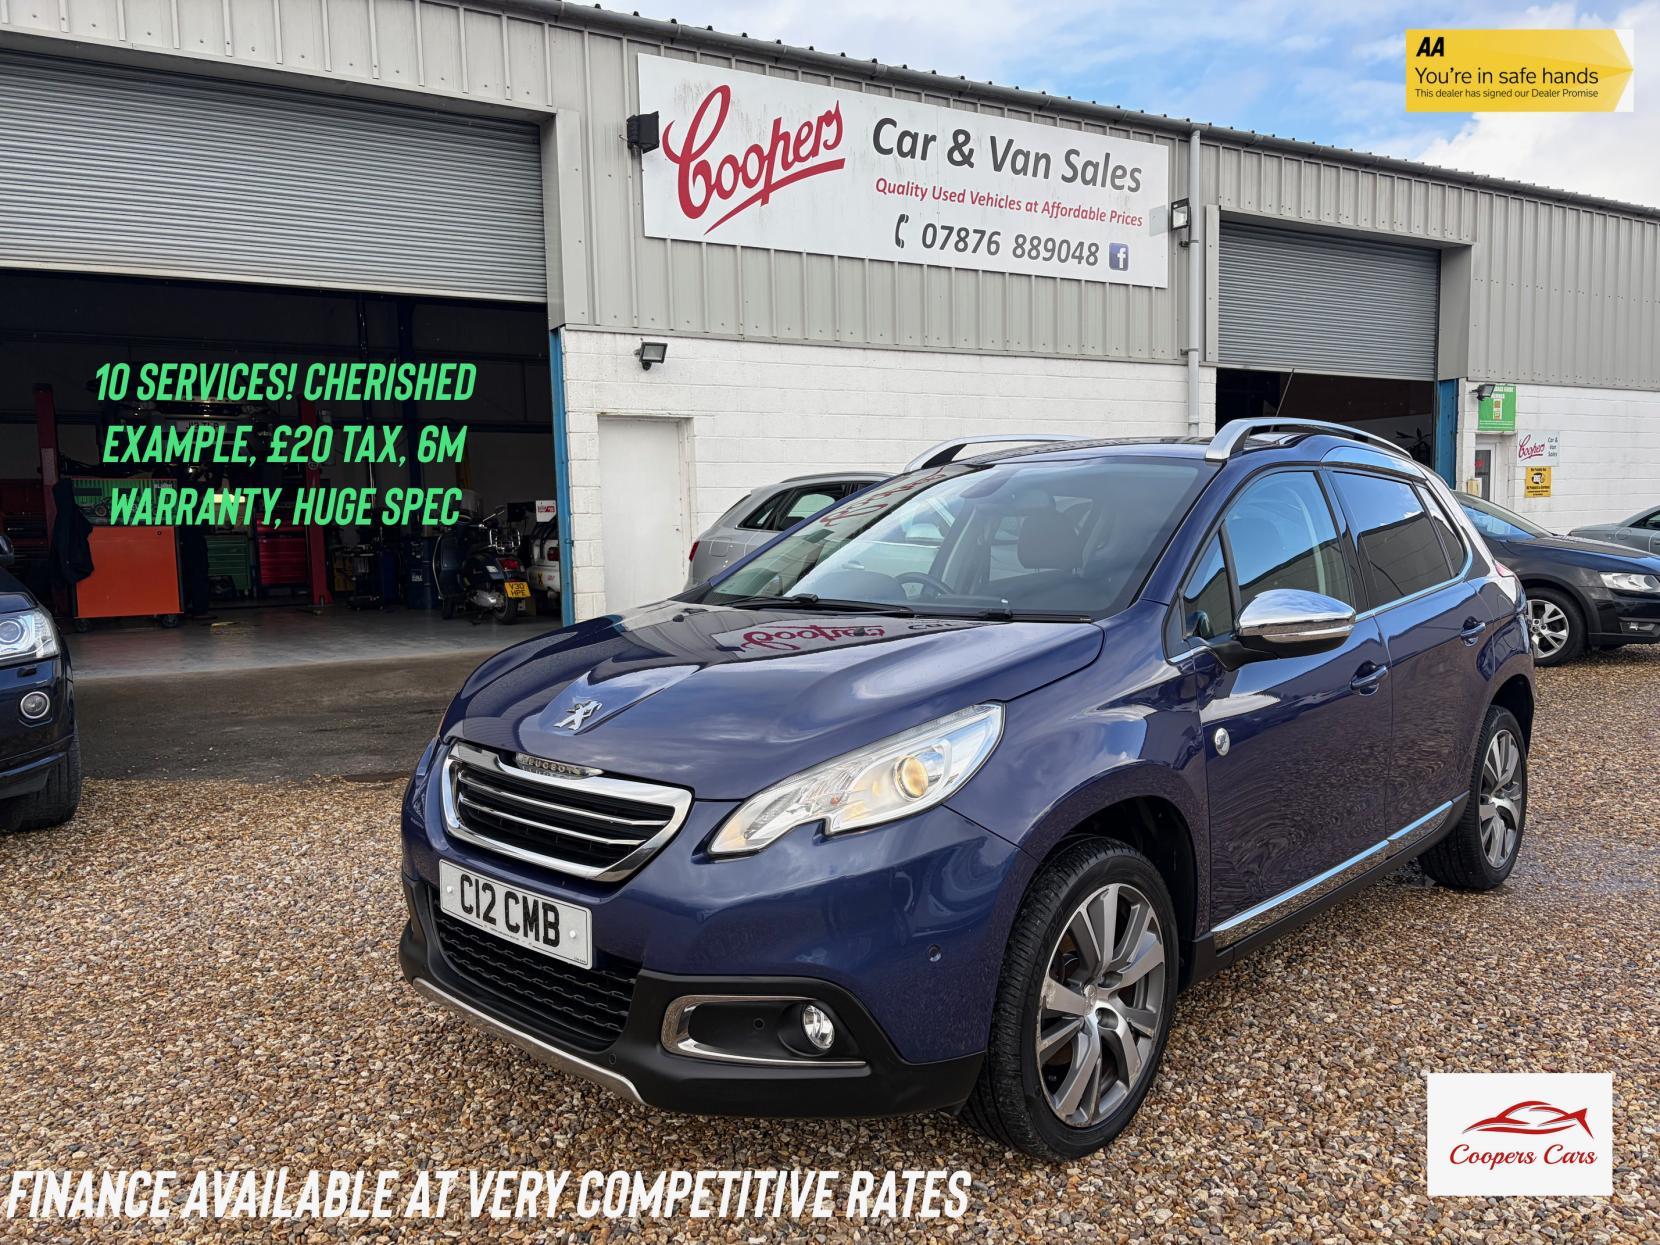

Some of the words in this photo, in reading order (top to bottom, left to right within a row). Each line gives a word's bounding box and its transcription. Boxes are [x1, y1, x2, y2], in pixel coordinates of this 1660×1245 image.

[662, 84, 846, 222] Coopers
[872, 117, 937, 162] Car
[947, 128, 974, 169] &
[989, 135, 1052, 180] Van
[1062, 148, 1142, 193] Sales
[875, 177, 928, 202] Quality
[931, 185, 965, 206] Used
[969, 188, 1022, 212] Vehicles
[1025, 200, 1039, 214] at
[1041, 200, 1107, 223] Affordable
[1109, 211, 1143, 228] Prices
[921, 222, 1001, 257] 07876
[1012, 233, 1100, 267] 889048
[460, 873, 497, 926] C12
[504, 890, 561, 949] CMB
